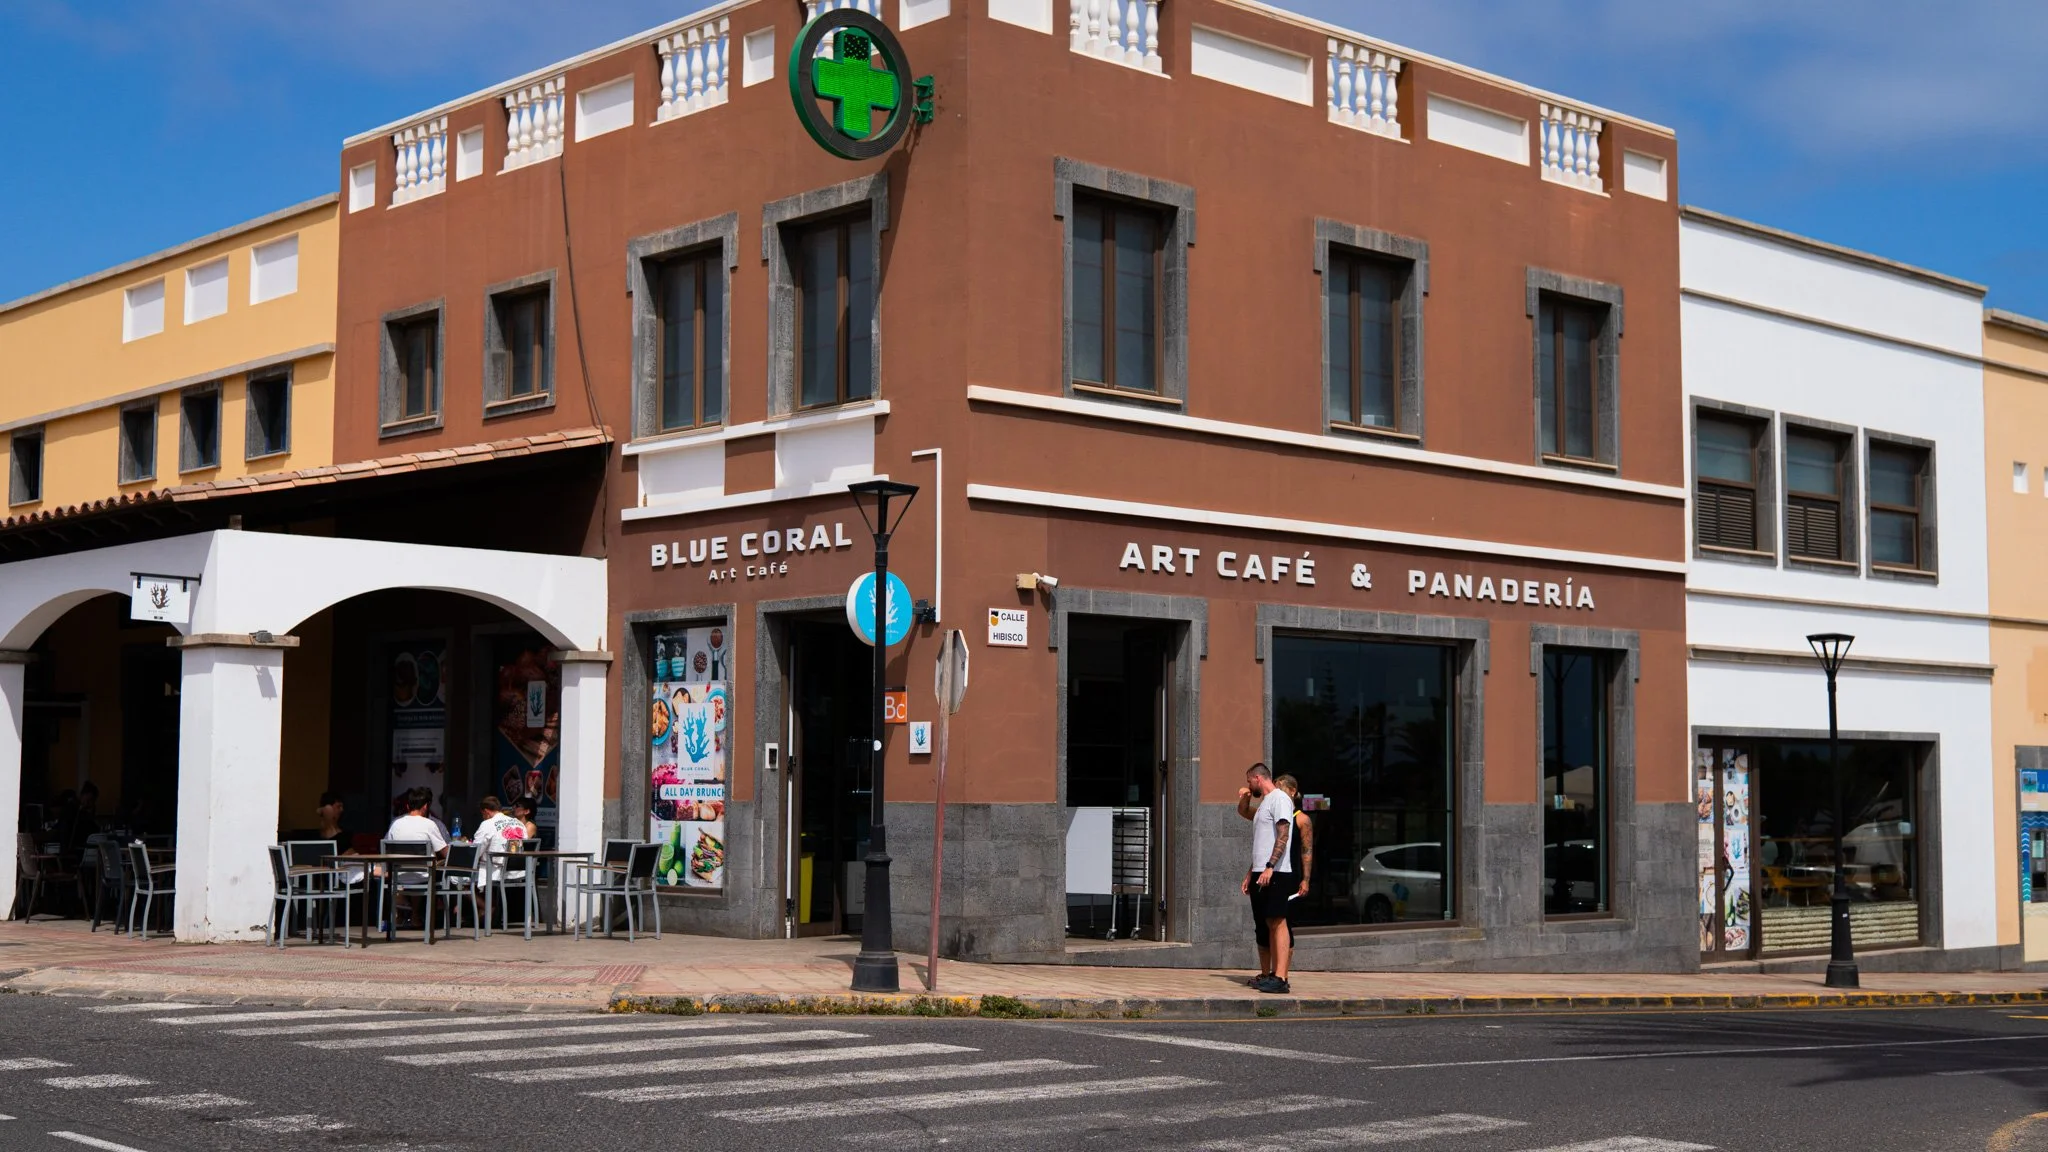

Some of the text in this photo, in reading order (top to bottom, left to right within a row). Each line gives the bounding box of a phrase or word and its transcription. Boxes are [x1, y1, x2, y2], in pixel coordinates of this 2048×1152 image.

[651, 522, 853, 567] BLUE CORAL
[708, 561, 788, 582] Art Café
[1118, 542, 1595, 609] ART CAFÉ & PANADERÍA
[1000, 612, 1025, 622] CALLE
[992, 632, 1024, 642] HIBISCO
[665, 787, 678, 797] ALL
[680, 787, 694, 797] DAY
